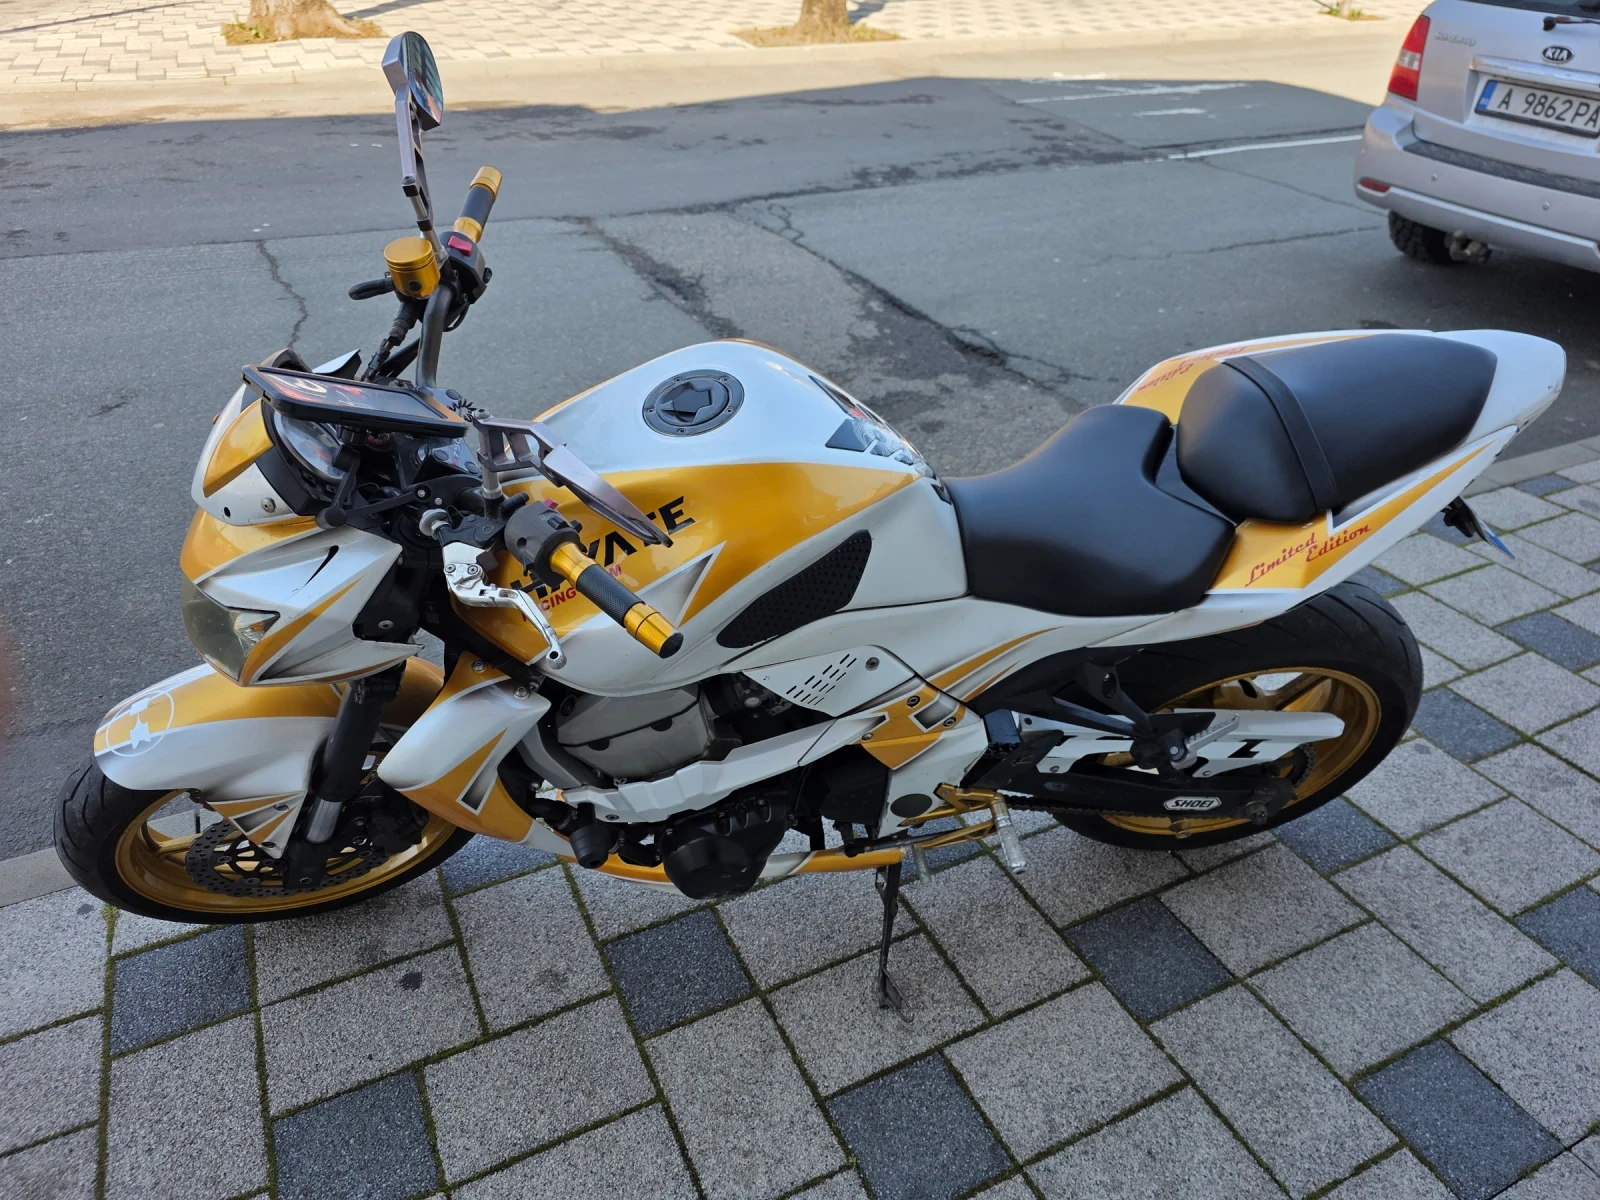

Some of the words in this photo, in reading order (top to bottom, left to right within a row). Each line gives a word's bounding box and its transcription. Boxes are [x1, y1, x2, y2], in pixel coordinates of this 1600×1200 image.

[1544, 48, 1570, 62] KIA
[1306, 524, 1371, 562] Edition
[1245, 532, 1317, 588] Limited
[1171, 799, 1215, 809] SHOEI
